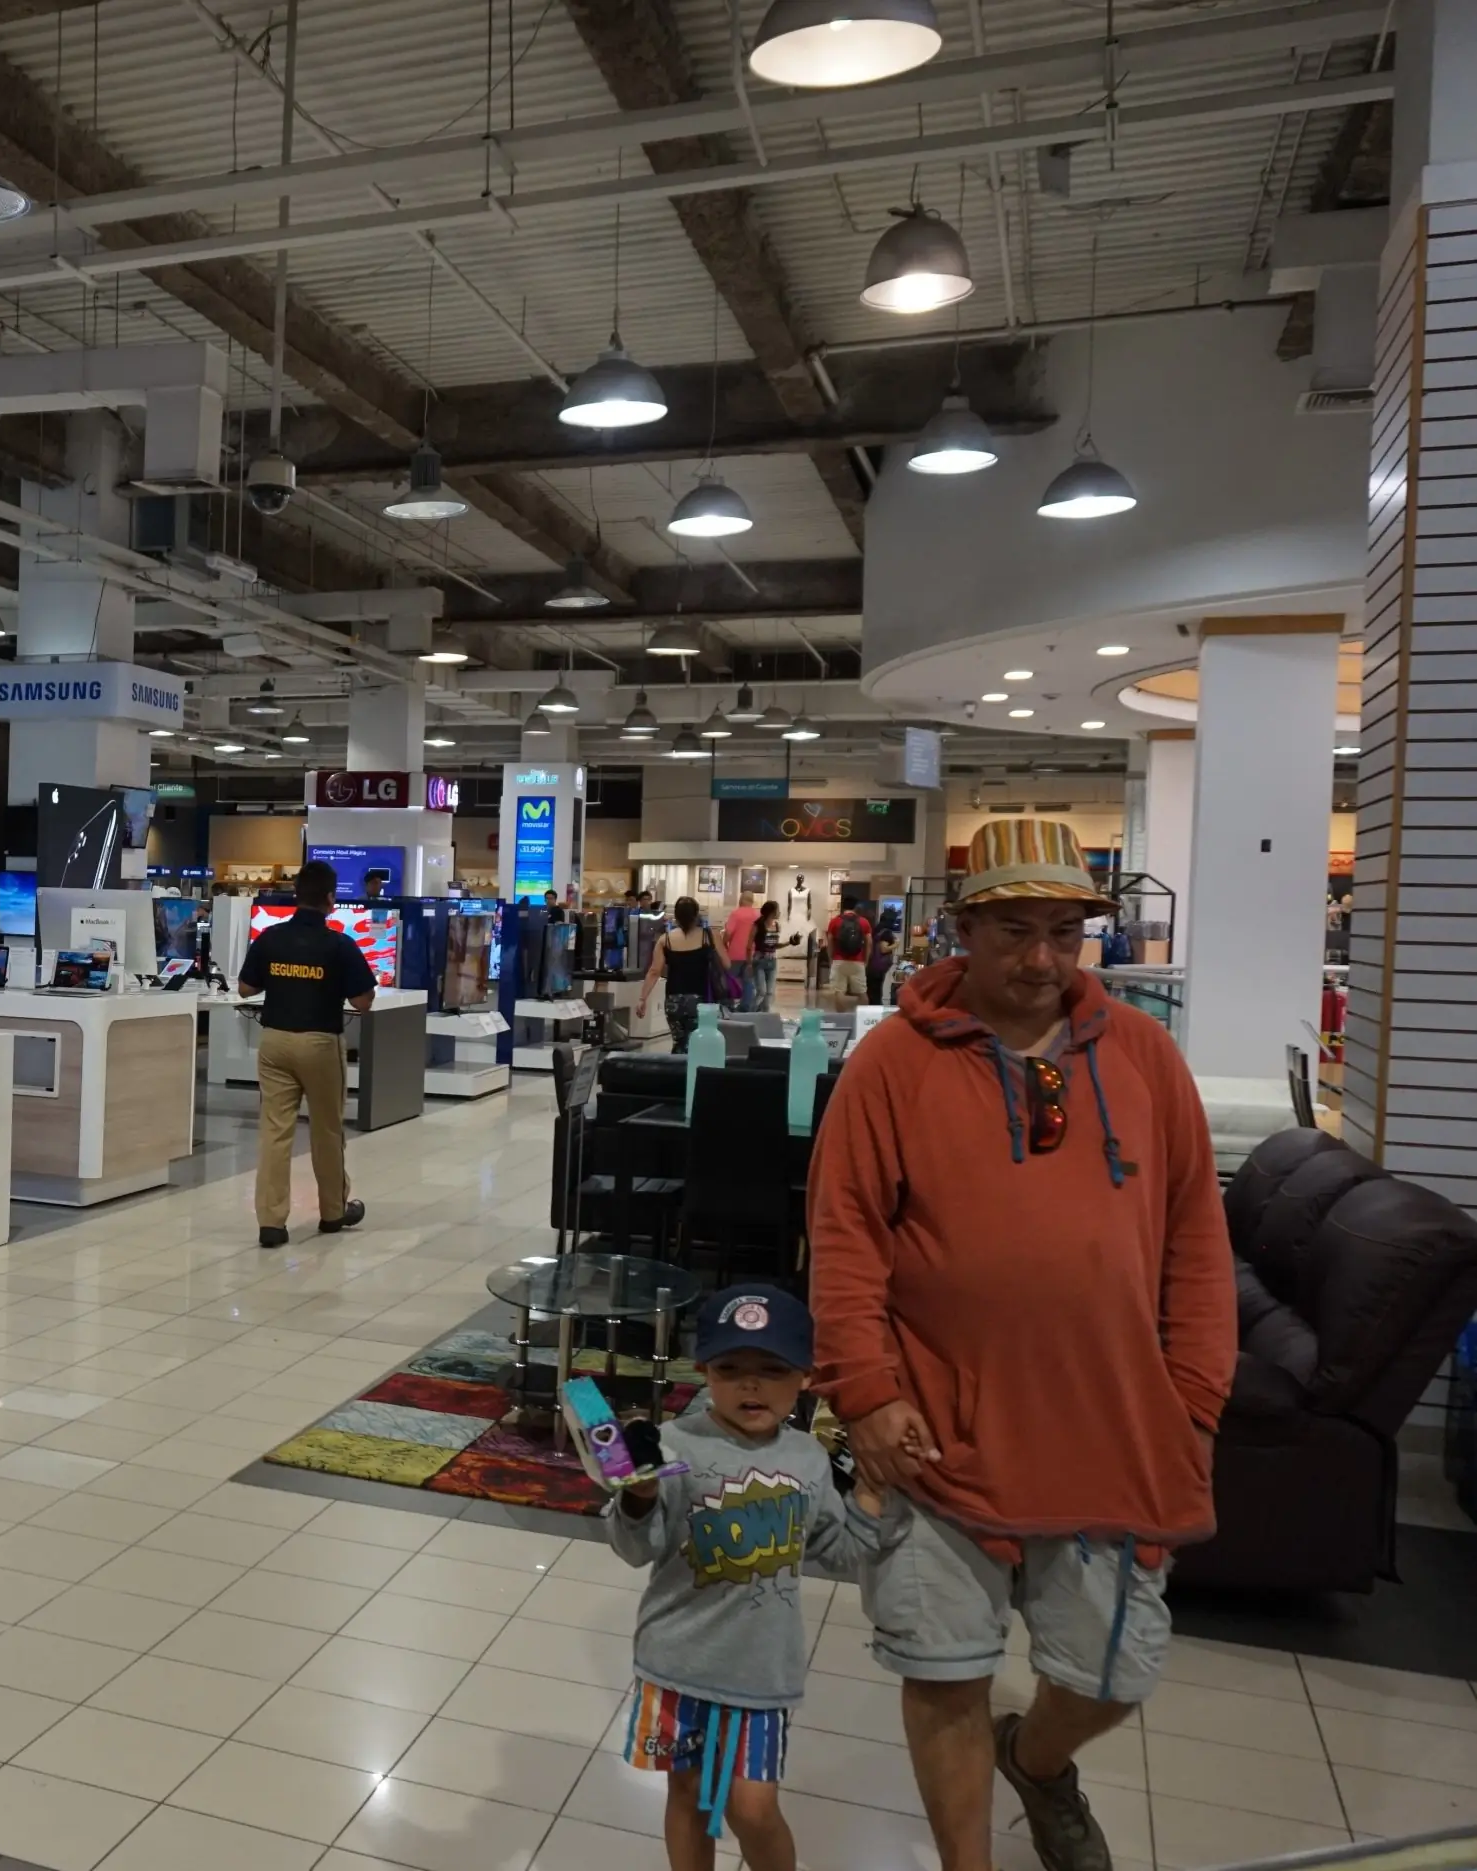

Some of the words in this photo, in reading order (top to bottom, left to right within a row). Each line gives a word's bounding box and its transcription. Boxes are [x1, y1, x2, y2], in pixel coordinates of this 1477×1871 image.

[131, 682, 179, 712] SAMSUNG
[157, 783, 184, 792] Cliente
[362, 778, 397, 800] LG
[447, 783, 458, 806] LG
[521, 821, 550, 829] movistar
[269, 961, 324, 980] SEGURIDAD
[689, 1490, 809, 1574] POW!
